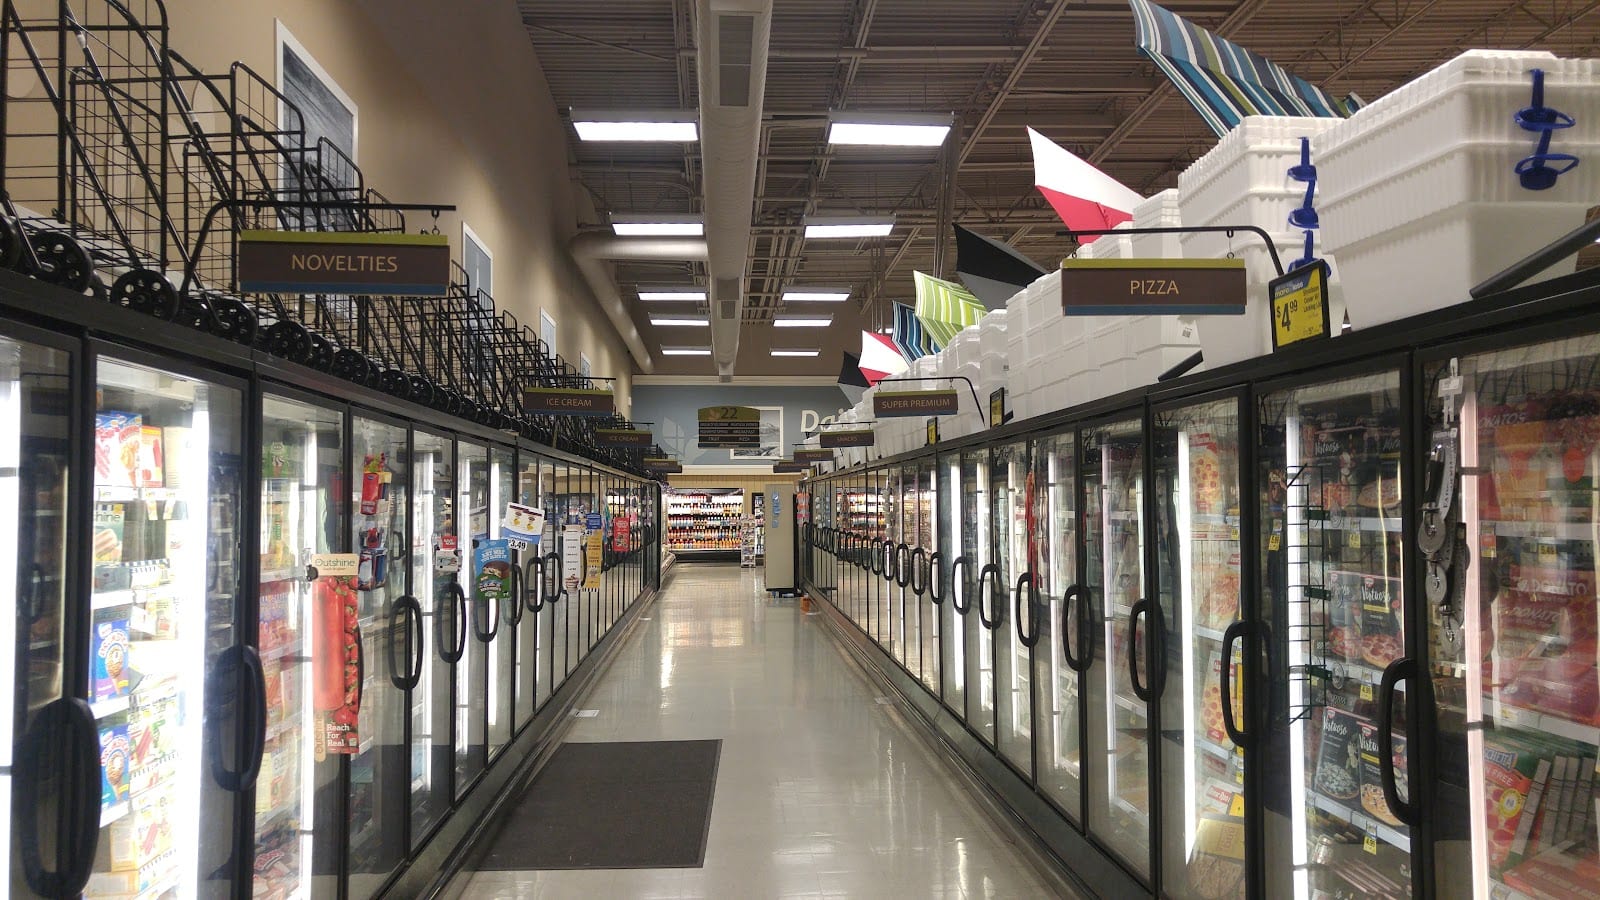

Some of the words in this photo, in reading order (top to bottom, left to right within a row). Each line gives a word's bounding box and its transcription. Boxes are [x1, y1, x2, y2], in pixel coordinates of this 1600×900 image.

[291, 253, 398, 273] NOVELTIES
[1130, 279, 1179, 295] PIZZA
[562, 399, 592, 407] CREAM
[881, 400, 908, 409] SUPER
[910, 398, 950, 408] PREMIUM
[720, 407, 738, 419] 22
[314, 558, 356, 567] Outshine
[326, 723, 350, 731] Reach
[327, 731, 340, 739] For
[327, 739, 345, 747] Real
